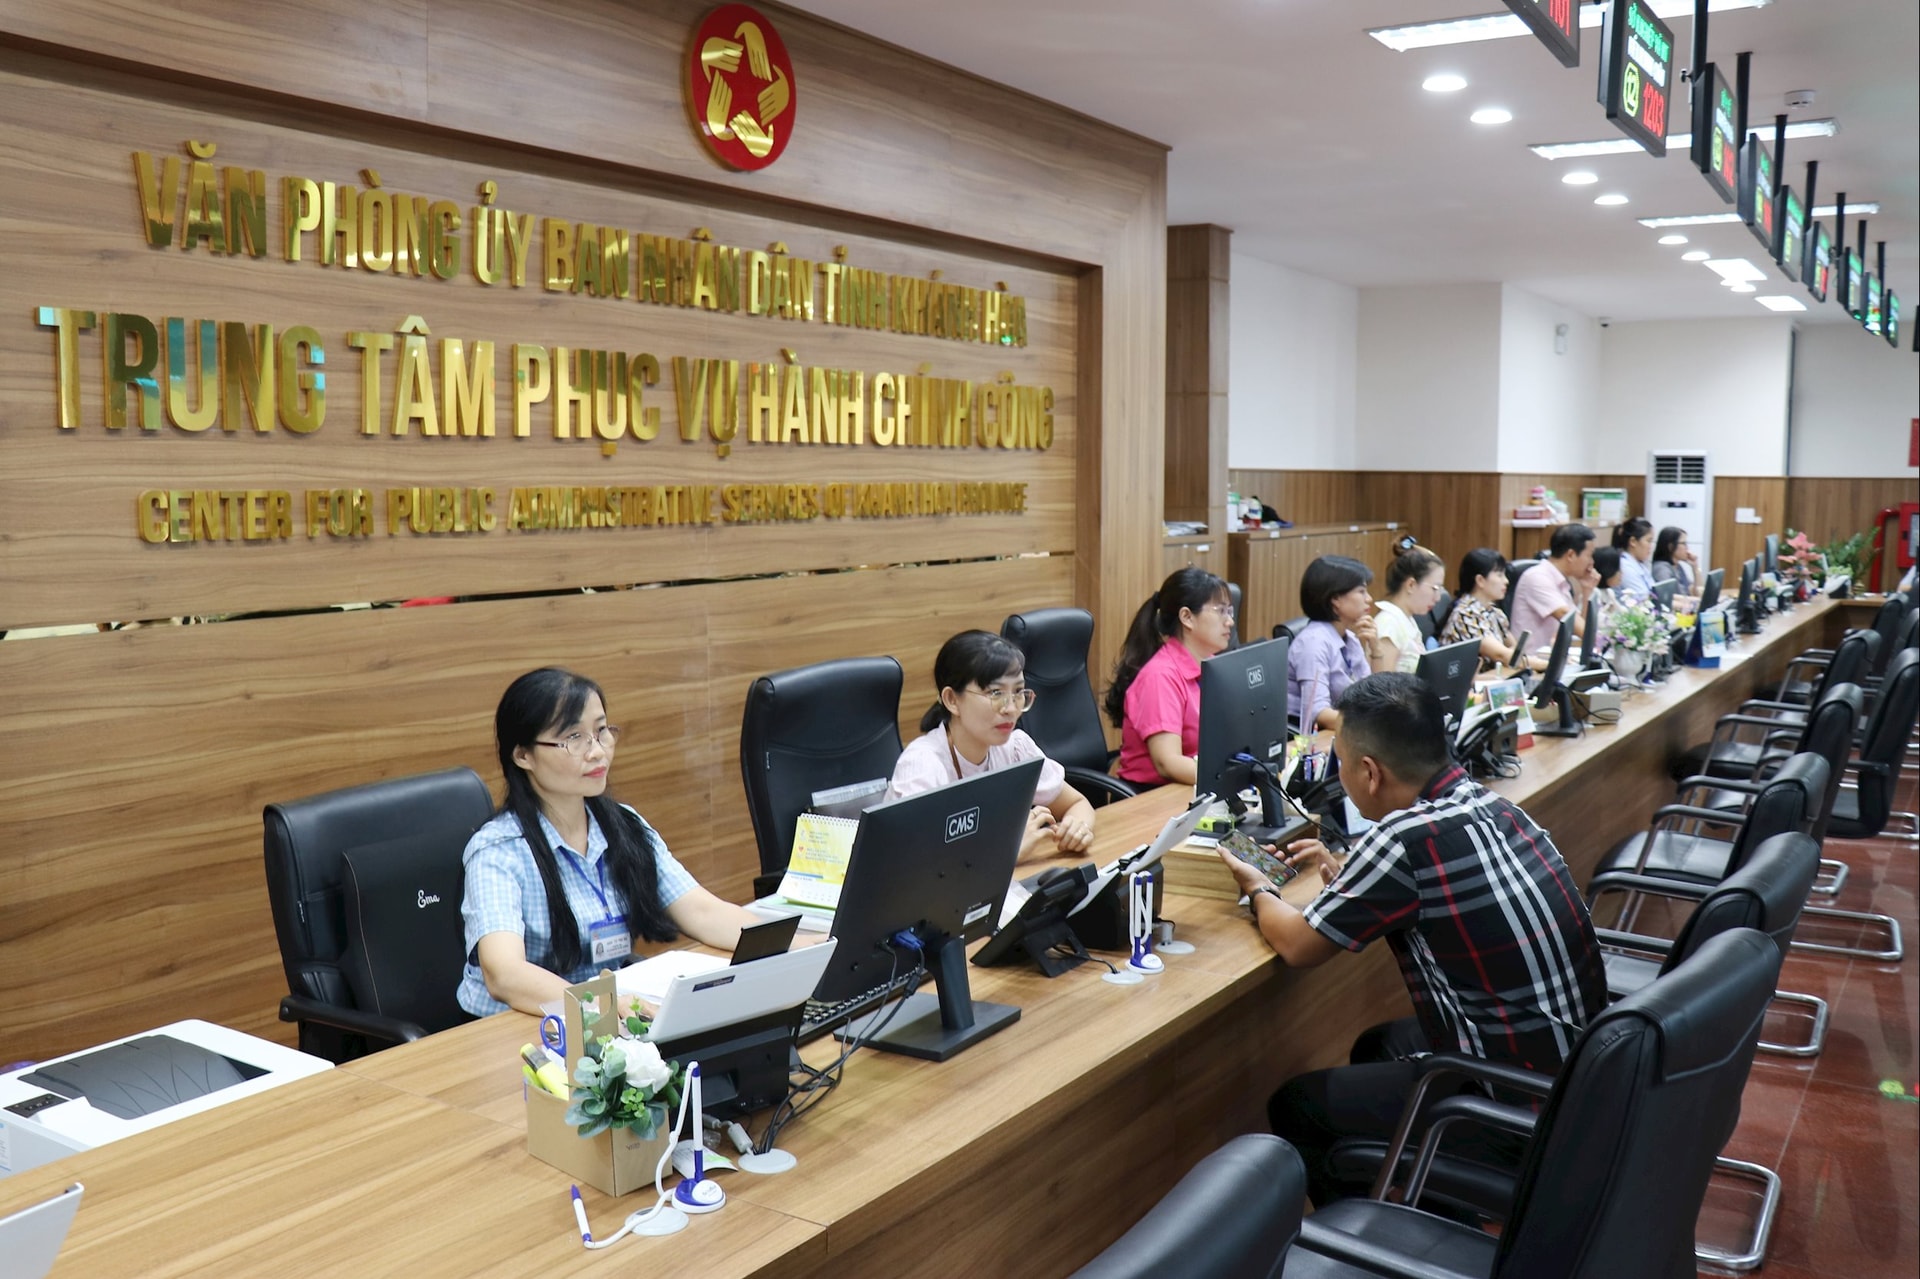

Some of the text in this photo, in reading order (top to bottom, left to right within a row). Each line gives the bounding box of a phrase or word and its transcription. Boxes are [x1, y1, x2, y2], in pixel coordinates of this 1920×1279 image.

[1643, 82, 1664, 138] 1203
[132, 140, 267, 257] VĂN
[281, 168, 462, 280] PHÒNG
[472, 181, 535, 287] ỦY
[543, 217, 629, 298] BAN
[637, 228, 740, 312] NHÂN
[746, 241, 813, 321] DÂN
[818, 245, 887, 329] TỈNH
[35, 305, 1055, 458] TRUNG TÂM PHỤC VỤ HÀNH CHÍNH CÔNG
[138, 488, 293, 544] CENTER
[305, 488, 375, 538] FOR
[387, 487, 498, 536] PUBLIC
[507, 485, 715, 531] ADMINISTRATIVE
[722, 483, 820, 522] SERVICES
[824, 483, 852, 519] OF
[949, 812, 976, 837] CMS
[417, 889, 440, 909] Ema
